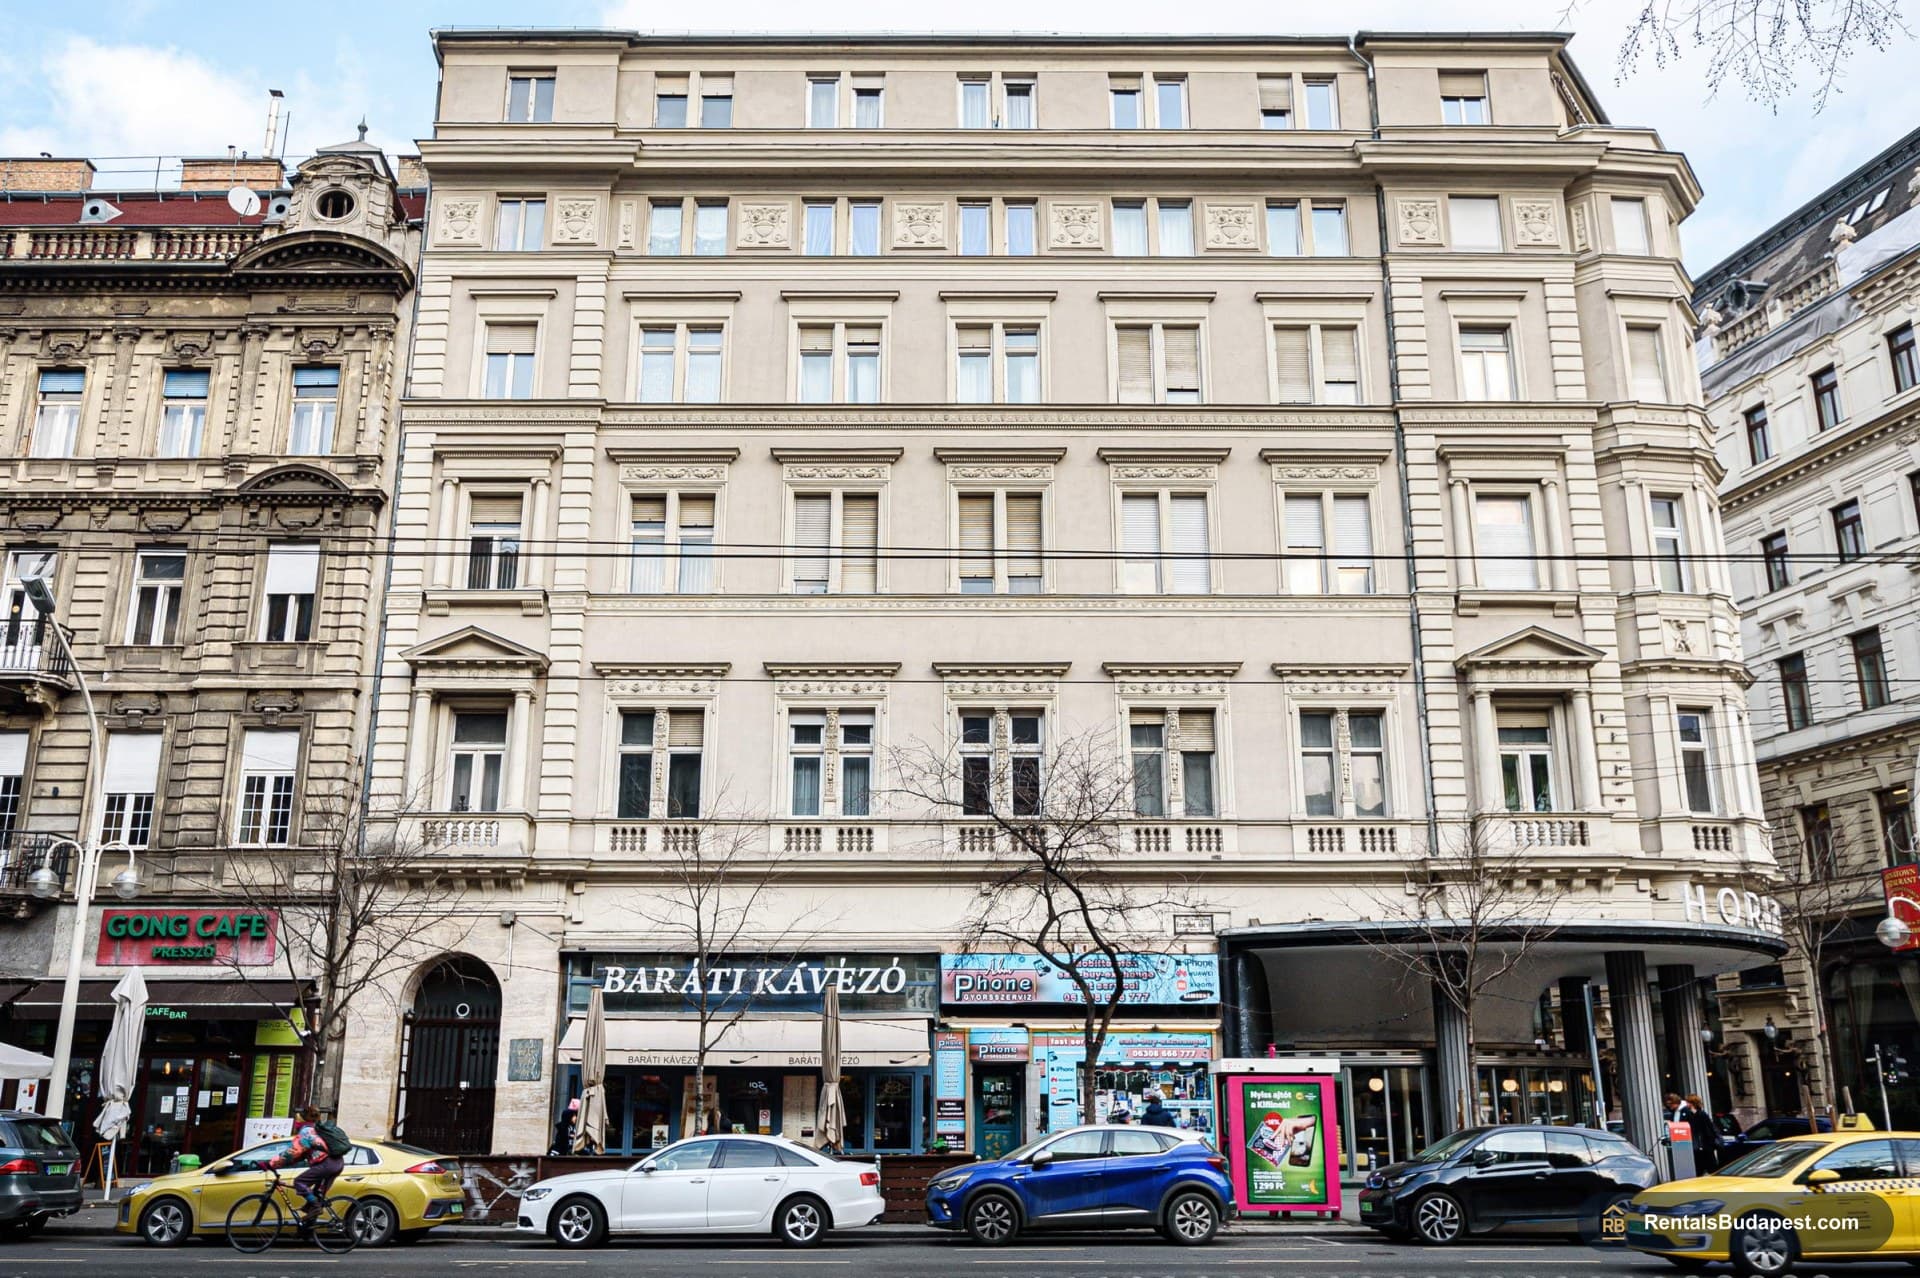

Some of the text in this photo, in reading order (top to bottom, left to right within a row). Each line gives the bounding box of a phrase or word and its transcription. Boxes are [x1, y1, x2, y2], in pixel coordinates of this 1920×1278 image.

[107, 914, 268, 938] GONG CAFE
[1184, 959, 1213, 968] iPhone
[603, 957, 907, 994] BARÁTI KÁVÉZÓ
[954, 974, 1033, 1001] Phone
[963, 993, 1033, 1001] GYORSSZERVIZ
[1083, 992, 1101, 1002] 38
[1128, 992, 1150, 1002] 777
[145, 1007, 188, 1020] CAFE BAR
[1050, 1037, 1068, 1045] fast
[979, 1045, 1017, 1058] Phone
[1180, 1050, 1197, 1058] 777
[627, 1054, 661, 1064] BARÁTI
[788, 1056, 821, 1065] BARÁTI
